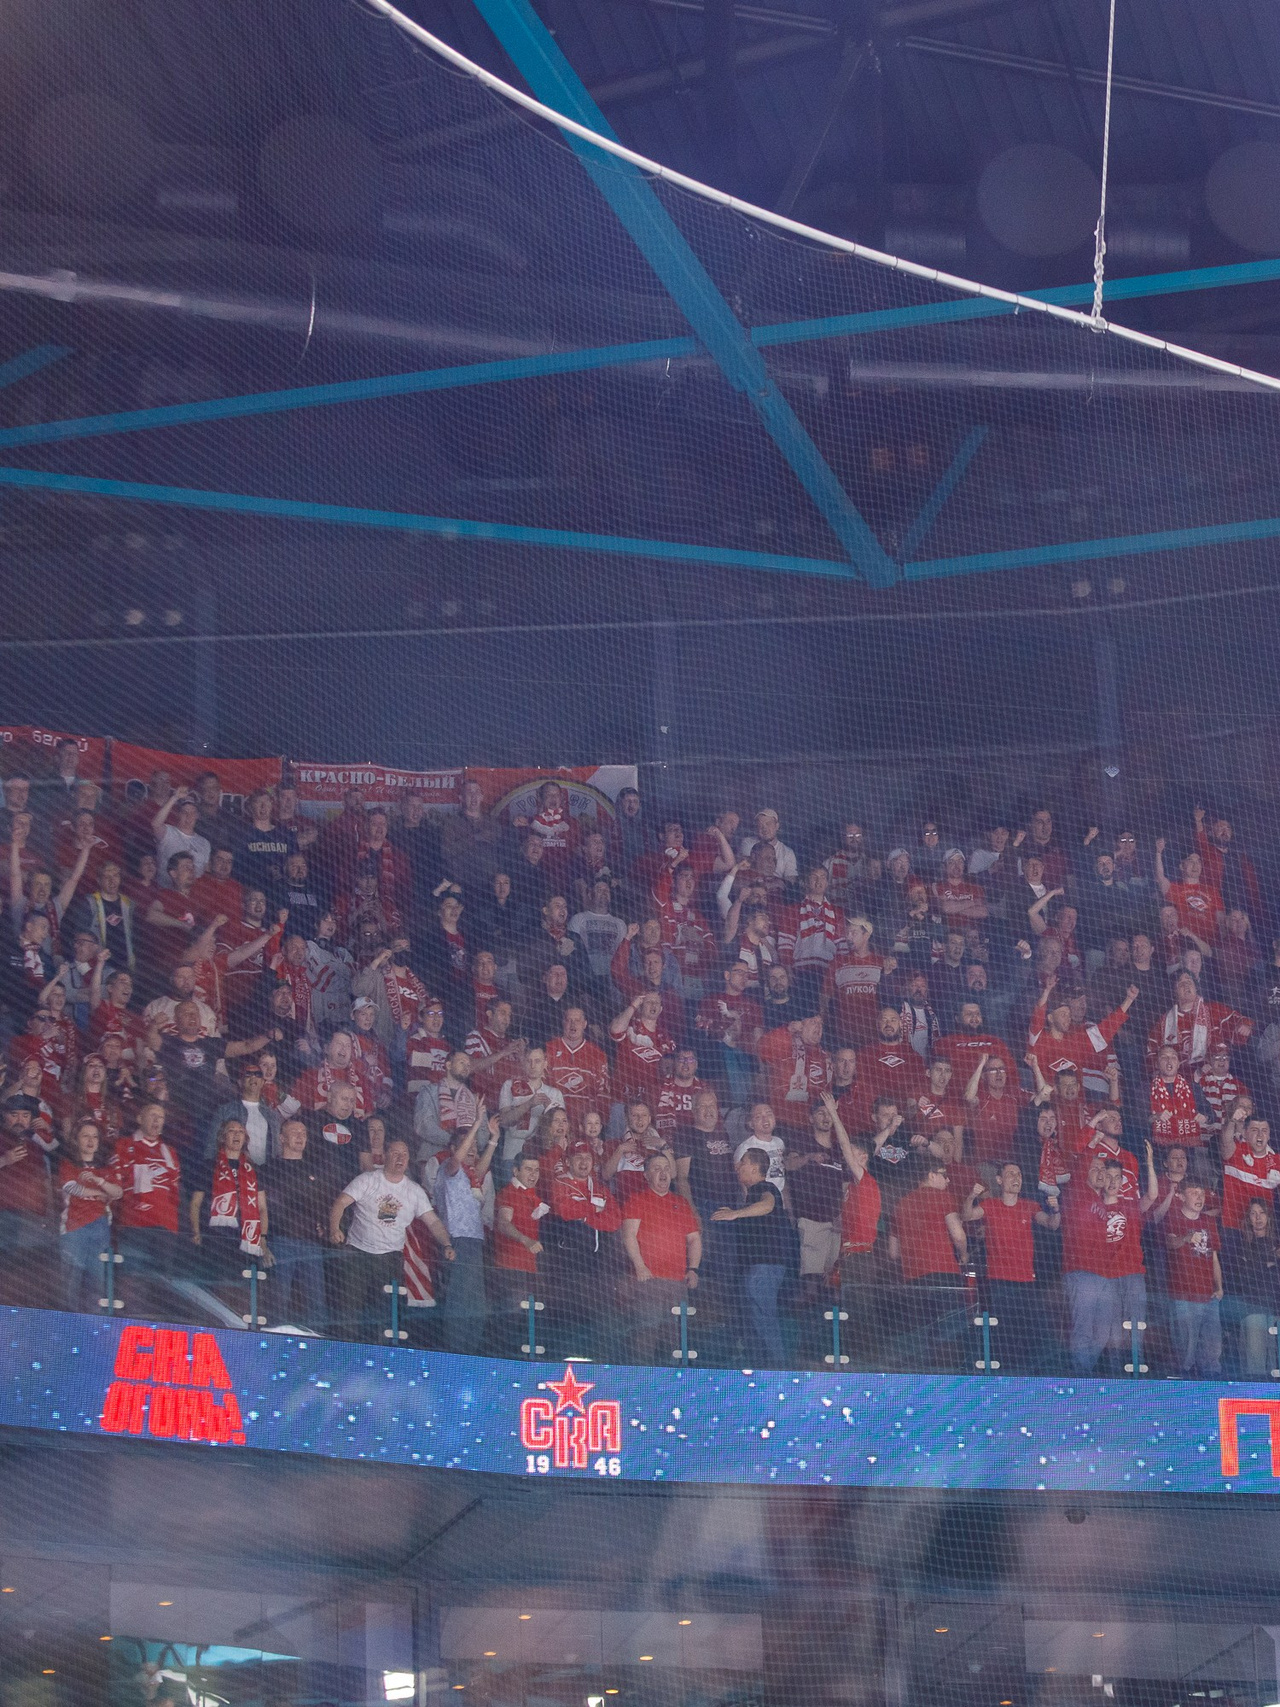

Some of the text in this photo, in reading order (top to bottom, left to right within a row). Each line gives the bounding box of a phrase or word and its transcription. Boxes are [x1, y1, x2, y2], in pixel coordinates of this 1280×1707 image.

[300, 770, 455, 789] КРАСНО-БЕЛЫЙ
[520, 1398, 622, 1469] СКА
[526, 1455, 622, 1476] 19 46
